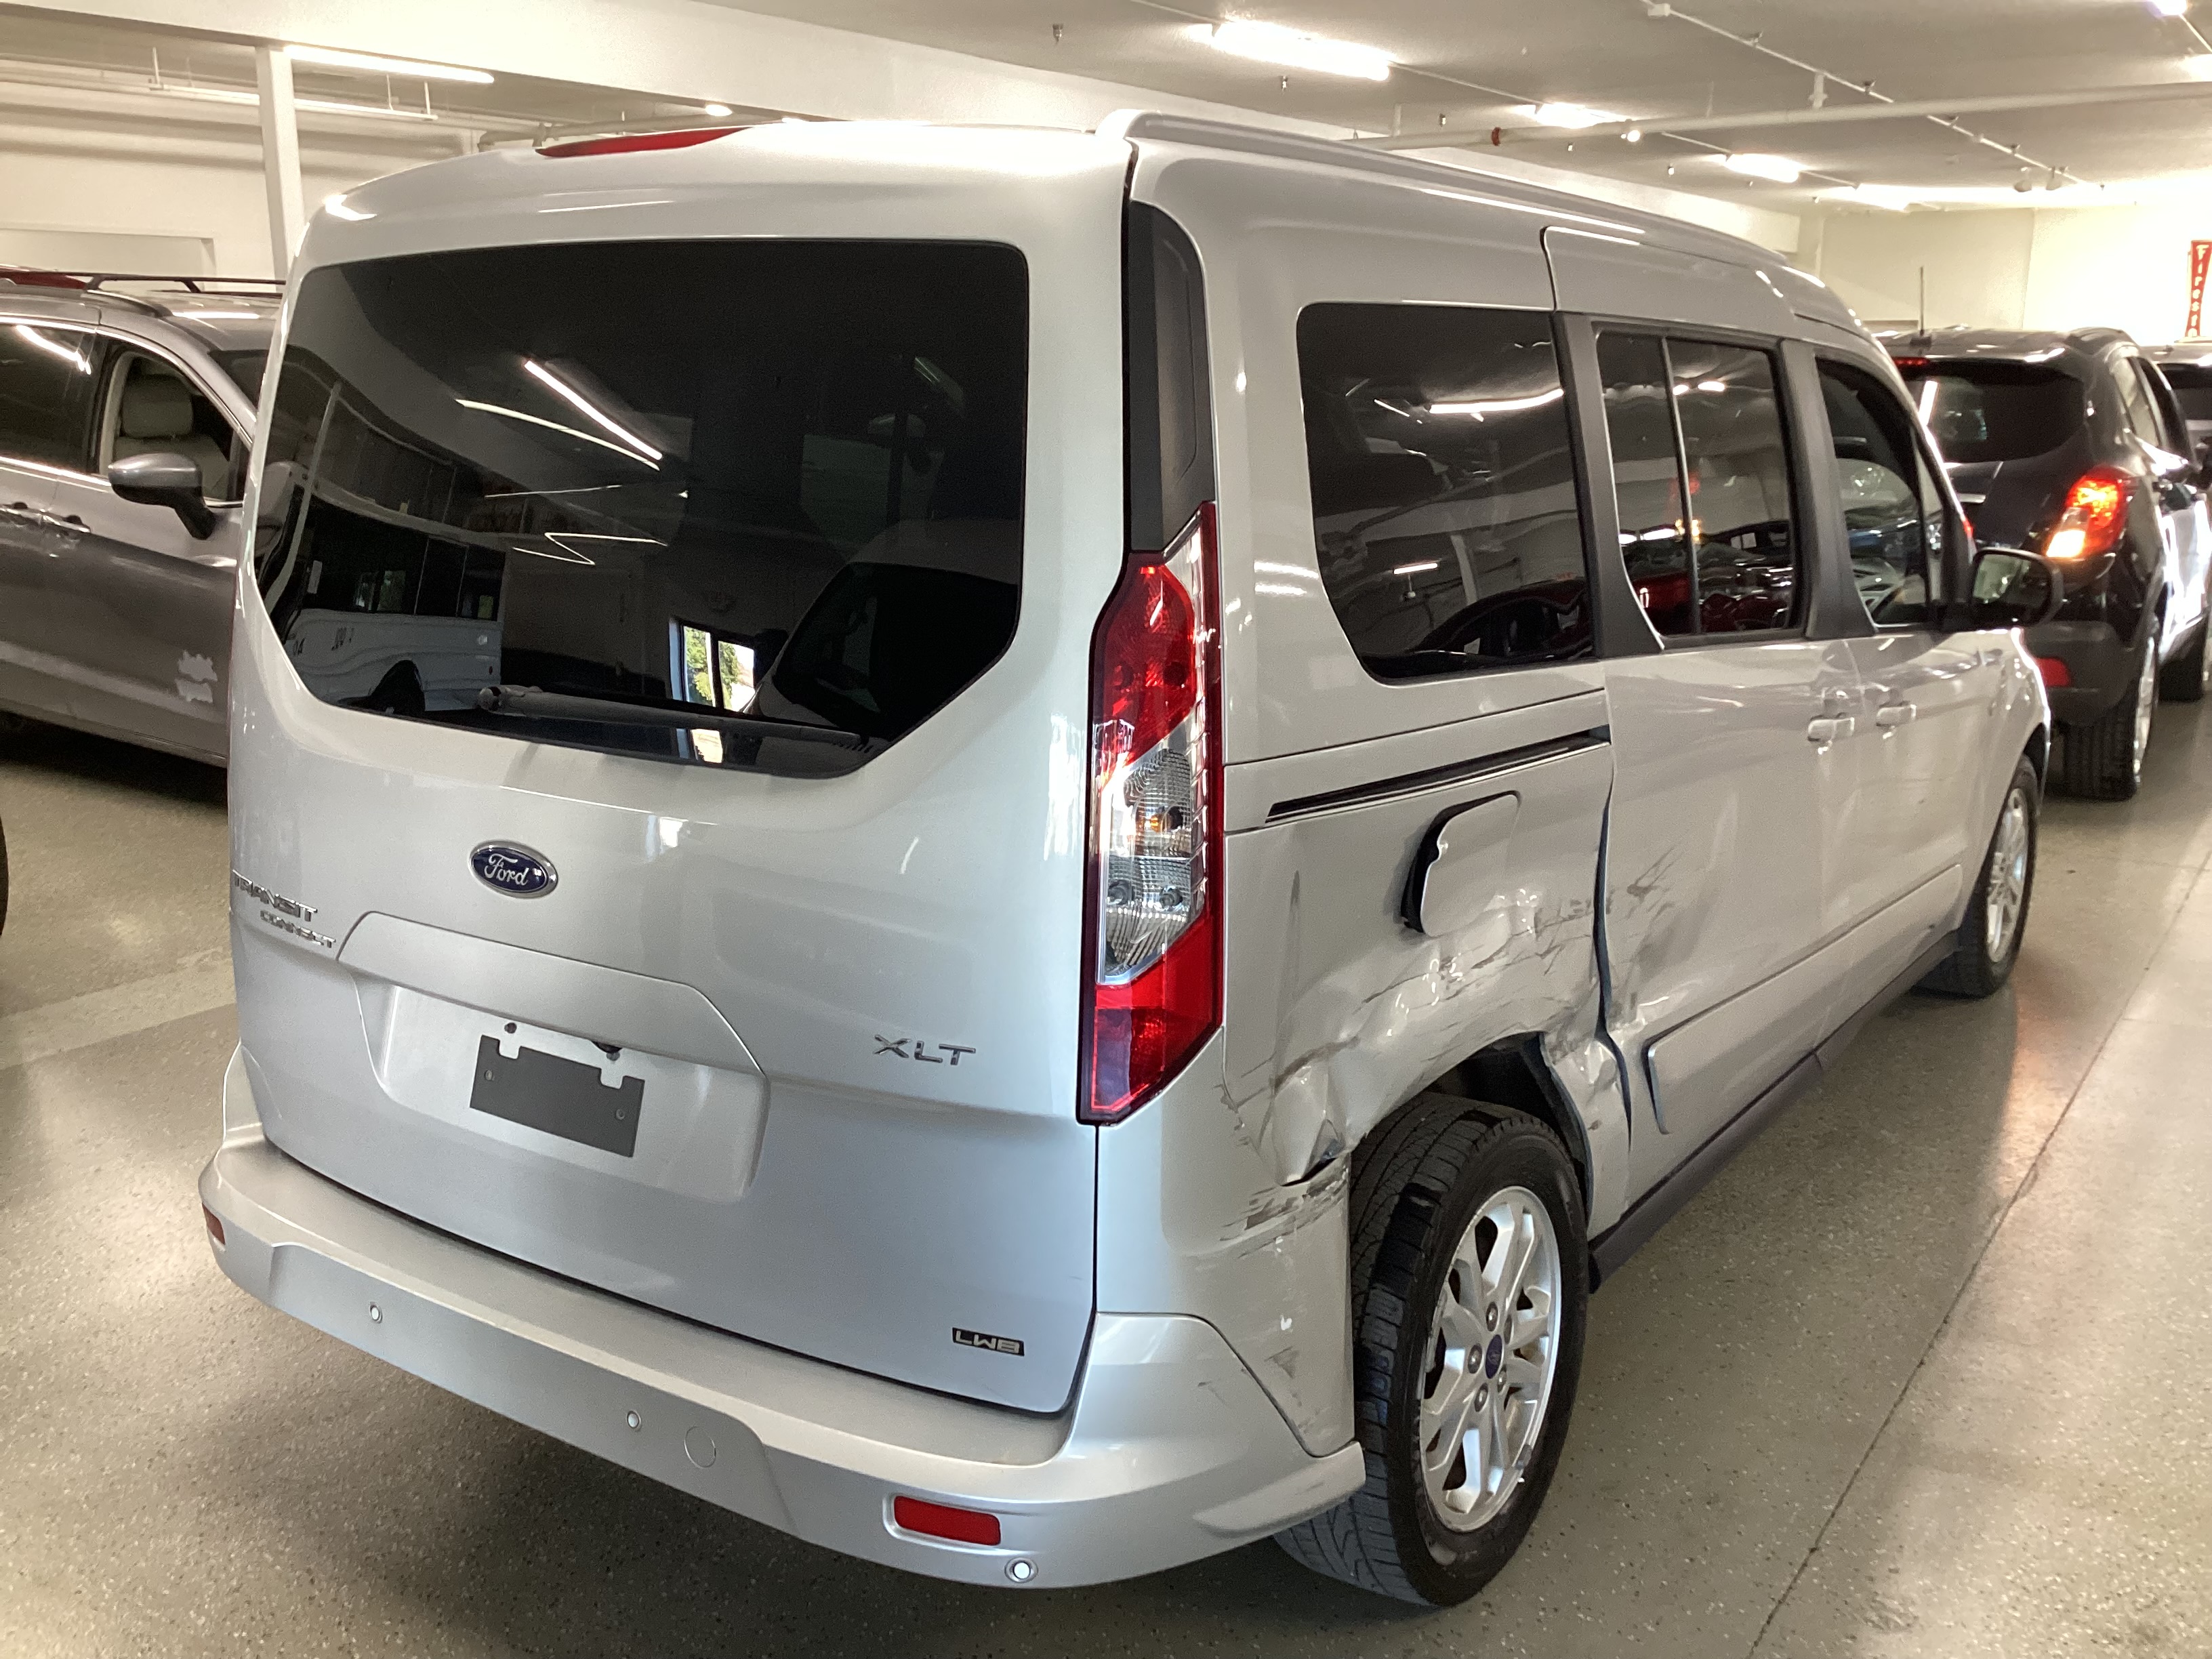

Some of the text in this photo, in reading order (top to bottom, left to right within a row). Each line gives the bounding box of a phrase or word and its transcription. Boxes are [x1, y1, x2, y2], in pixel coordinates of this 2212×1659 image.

[484, 853, 529, 886] Ford
[232, 869, 318, 922] TRANSIT
[873, 1034, 976, 1066] XLT
[955, 1330, 1020, 1354] LWB
